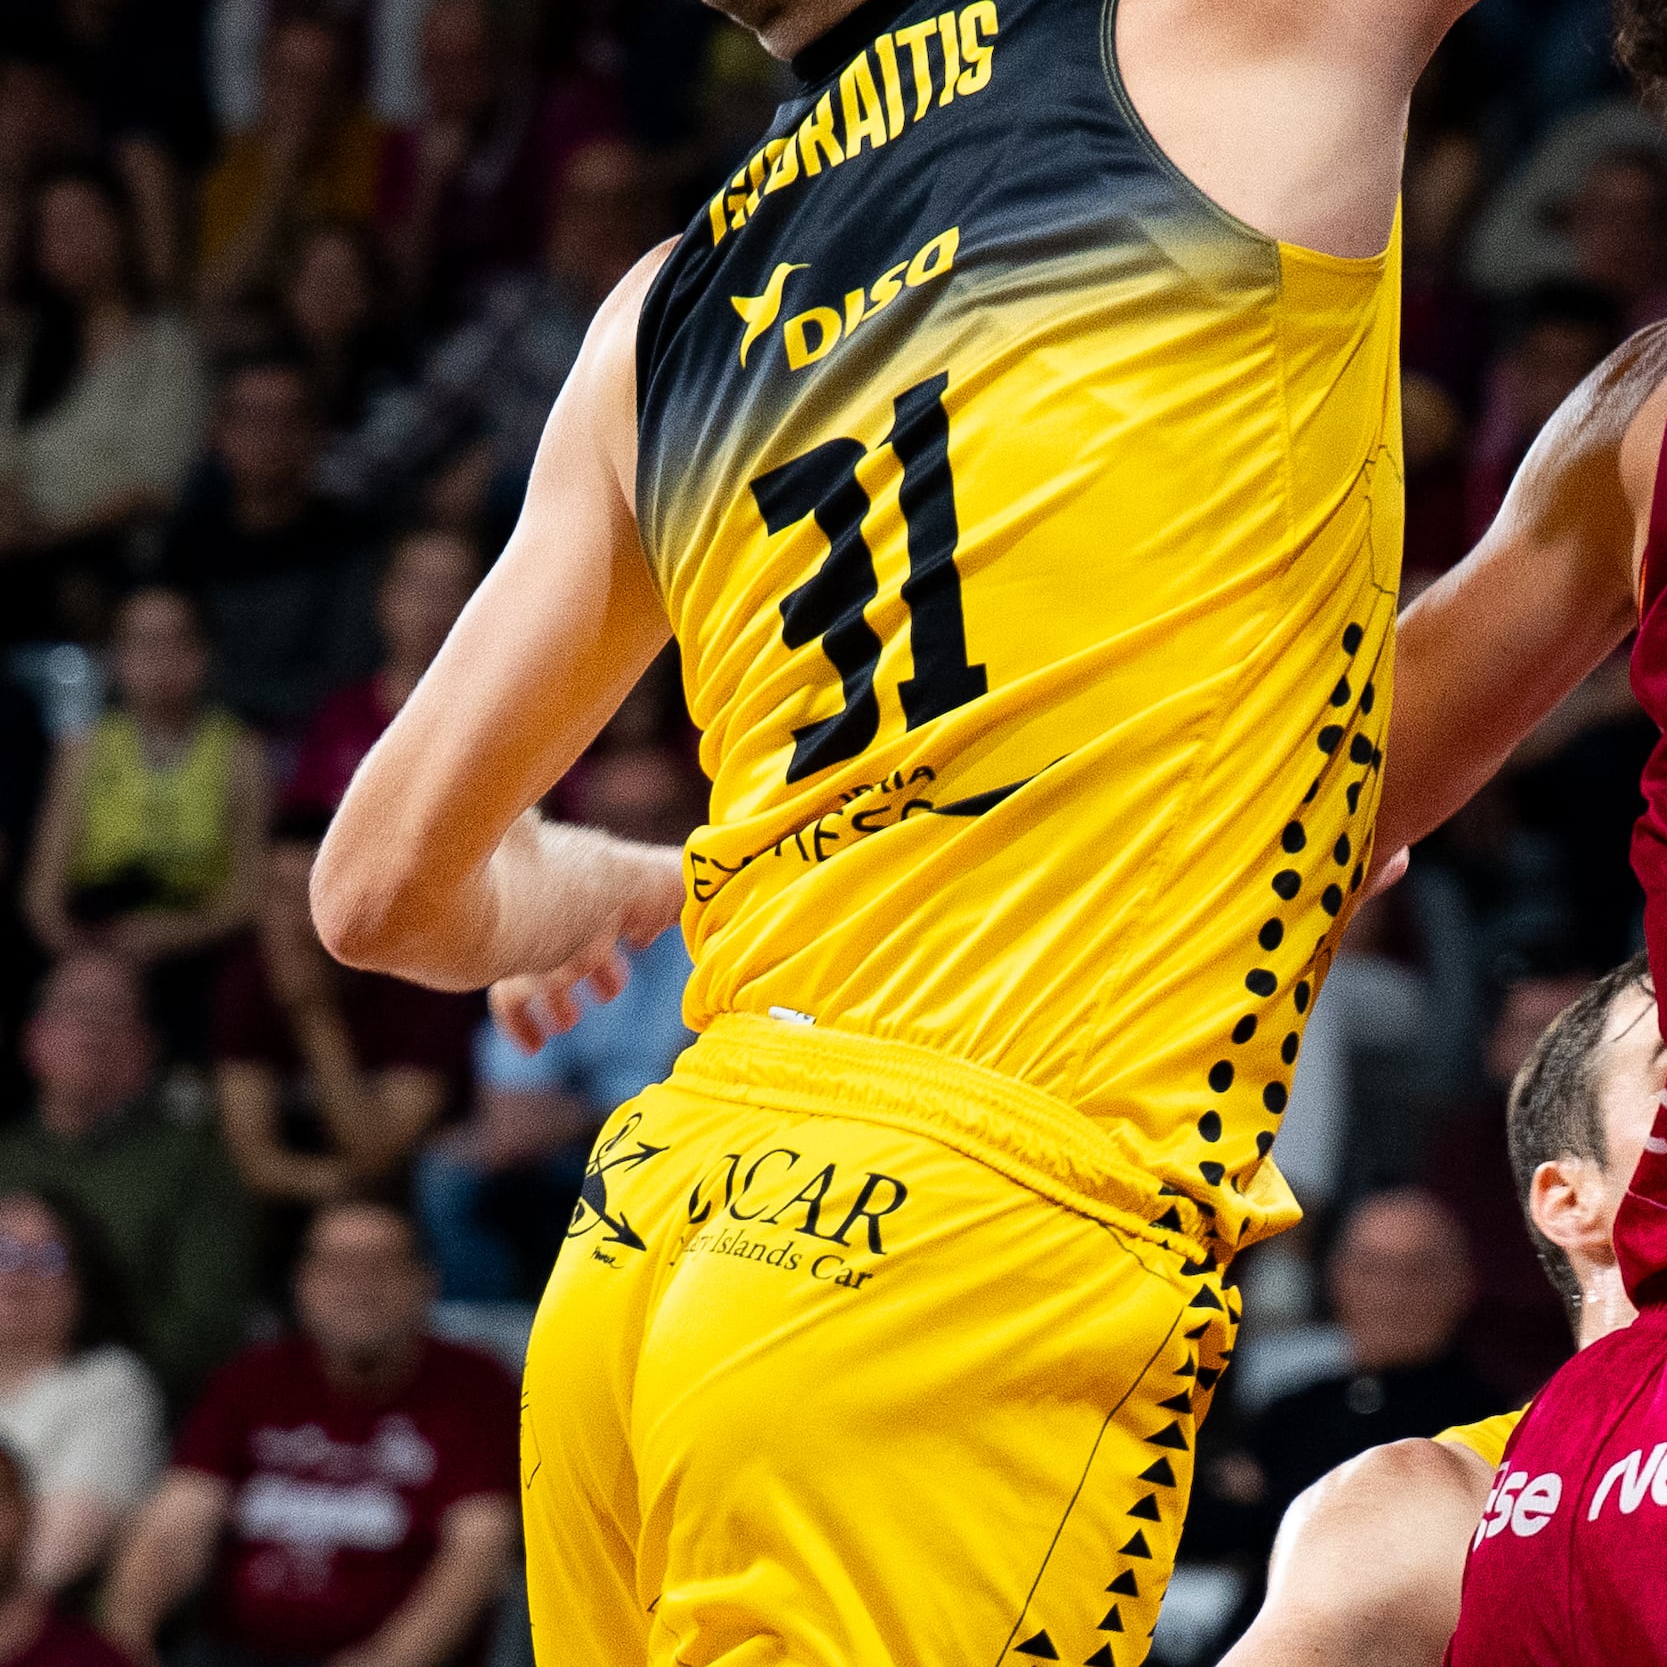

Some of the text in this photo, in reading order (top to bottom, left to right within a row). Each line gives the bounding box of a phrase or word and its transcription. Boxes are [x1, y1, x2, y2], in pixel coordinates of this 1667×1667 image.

[749, 370, 988, 785] 31
[709, 1227, 803, 1272] Islands
[810, 1254, 875, 1291] Car
